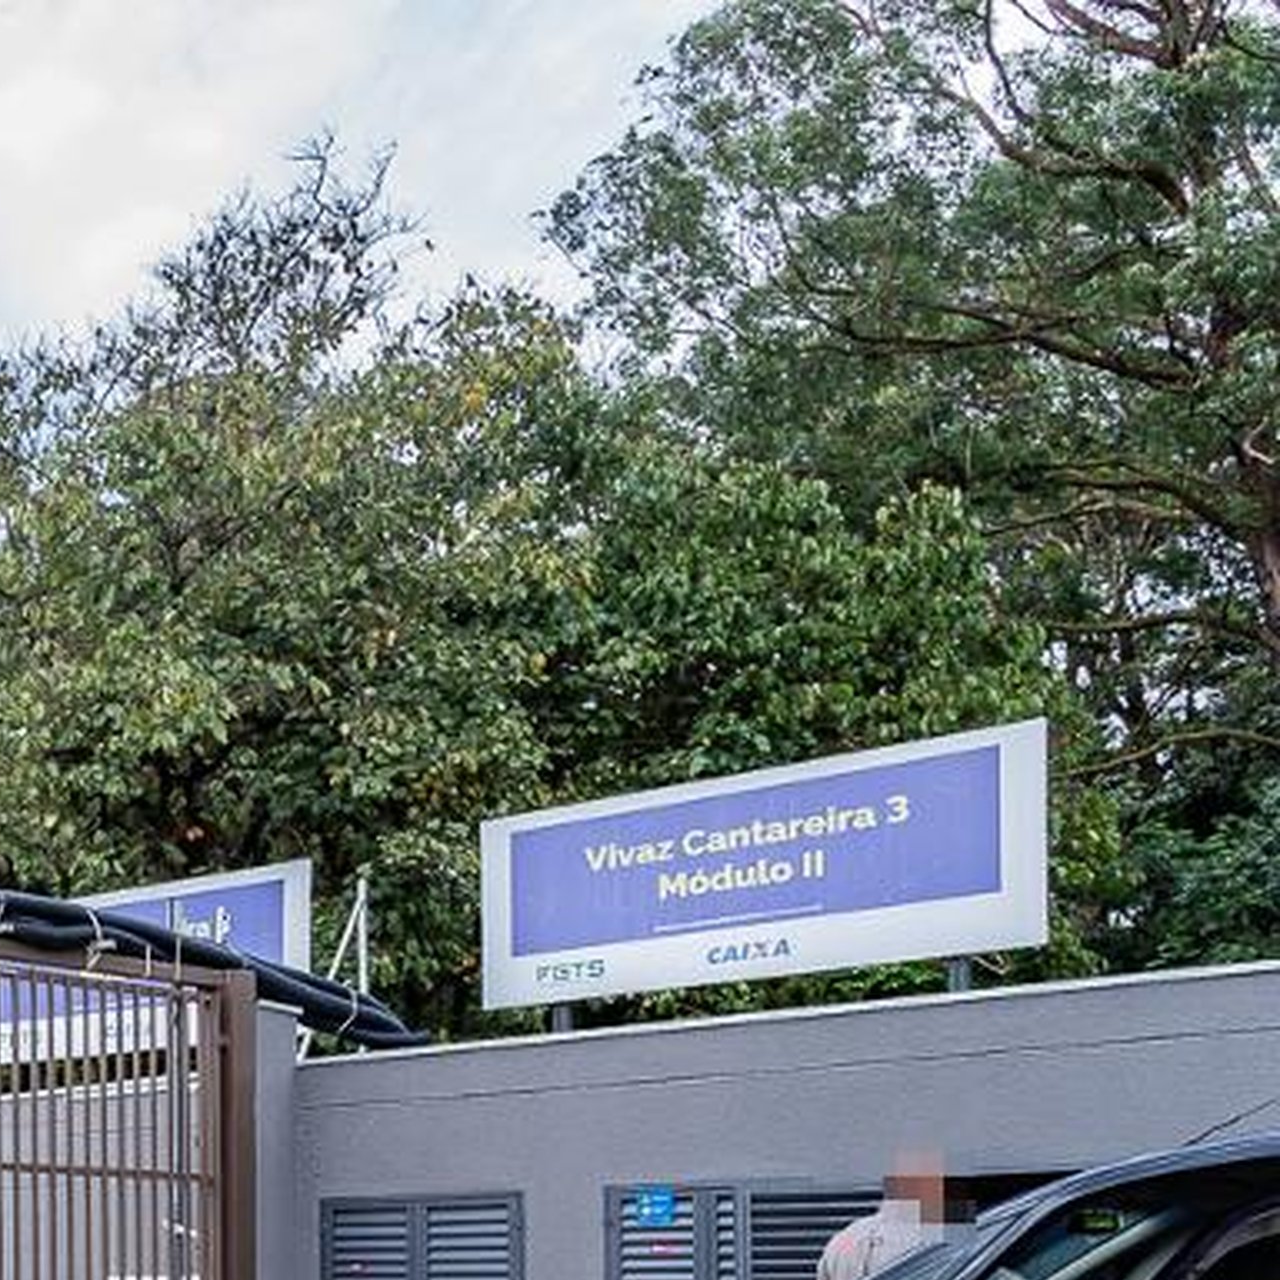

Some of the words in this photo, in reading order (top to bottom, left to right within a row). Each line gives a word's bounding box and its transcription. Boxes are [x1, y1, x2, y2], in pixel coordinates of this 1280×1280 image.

[585, 838, 675, 872] Vivaz
[682, 805, 877, 857] Cantareira
[885, 795, 910, 823] 3
[657, 858, 795, 900] Módulo
[802, 849, 826, 879] II
[706, 938, 792, 966] CAIXA
